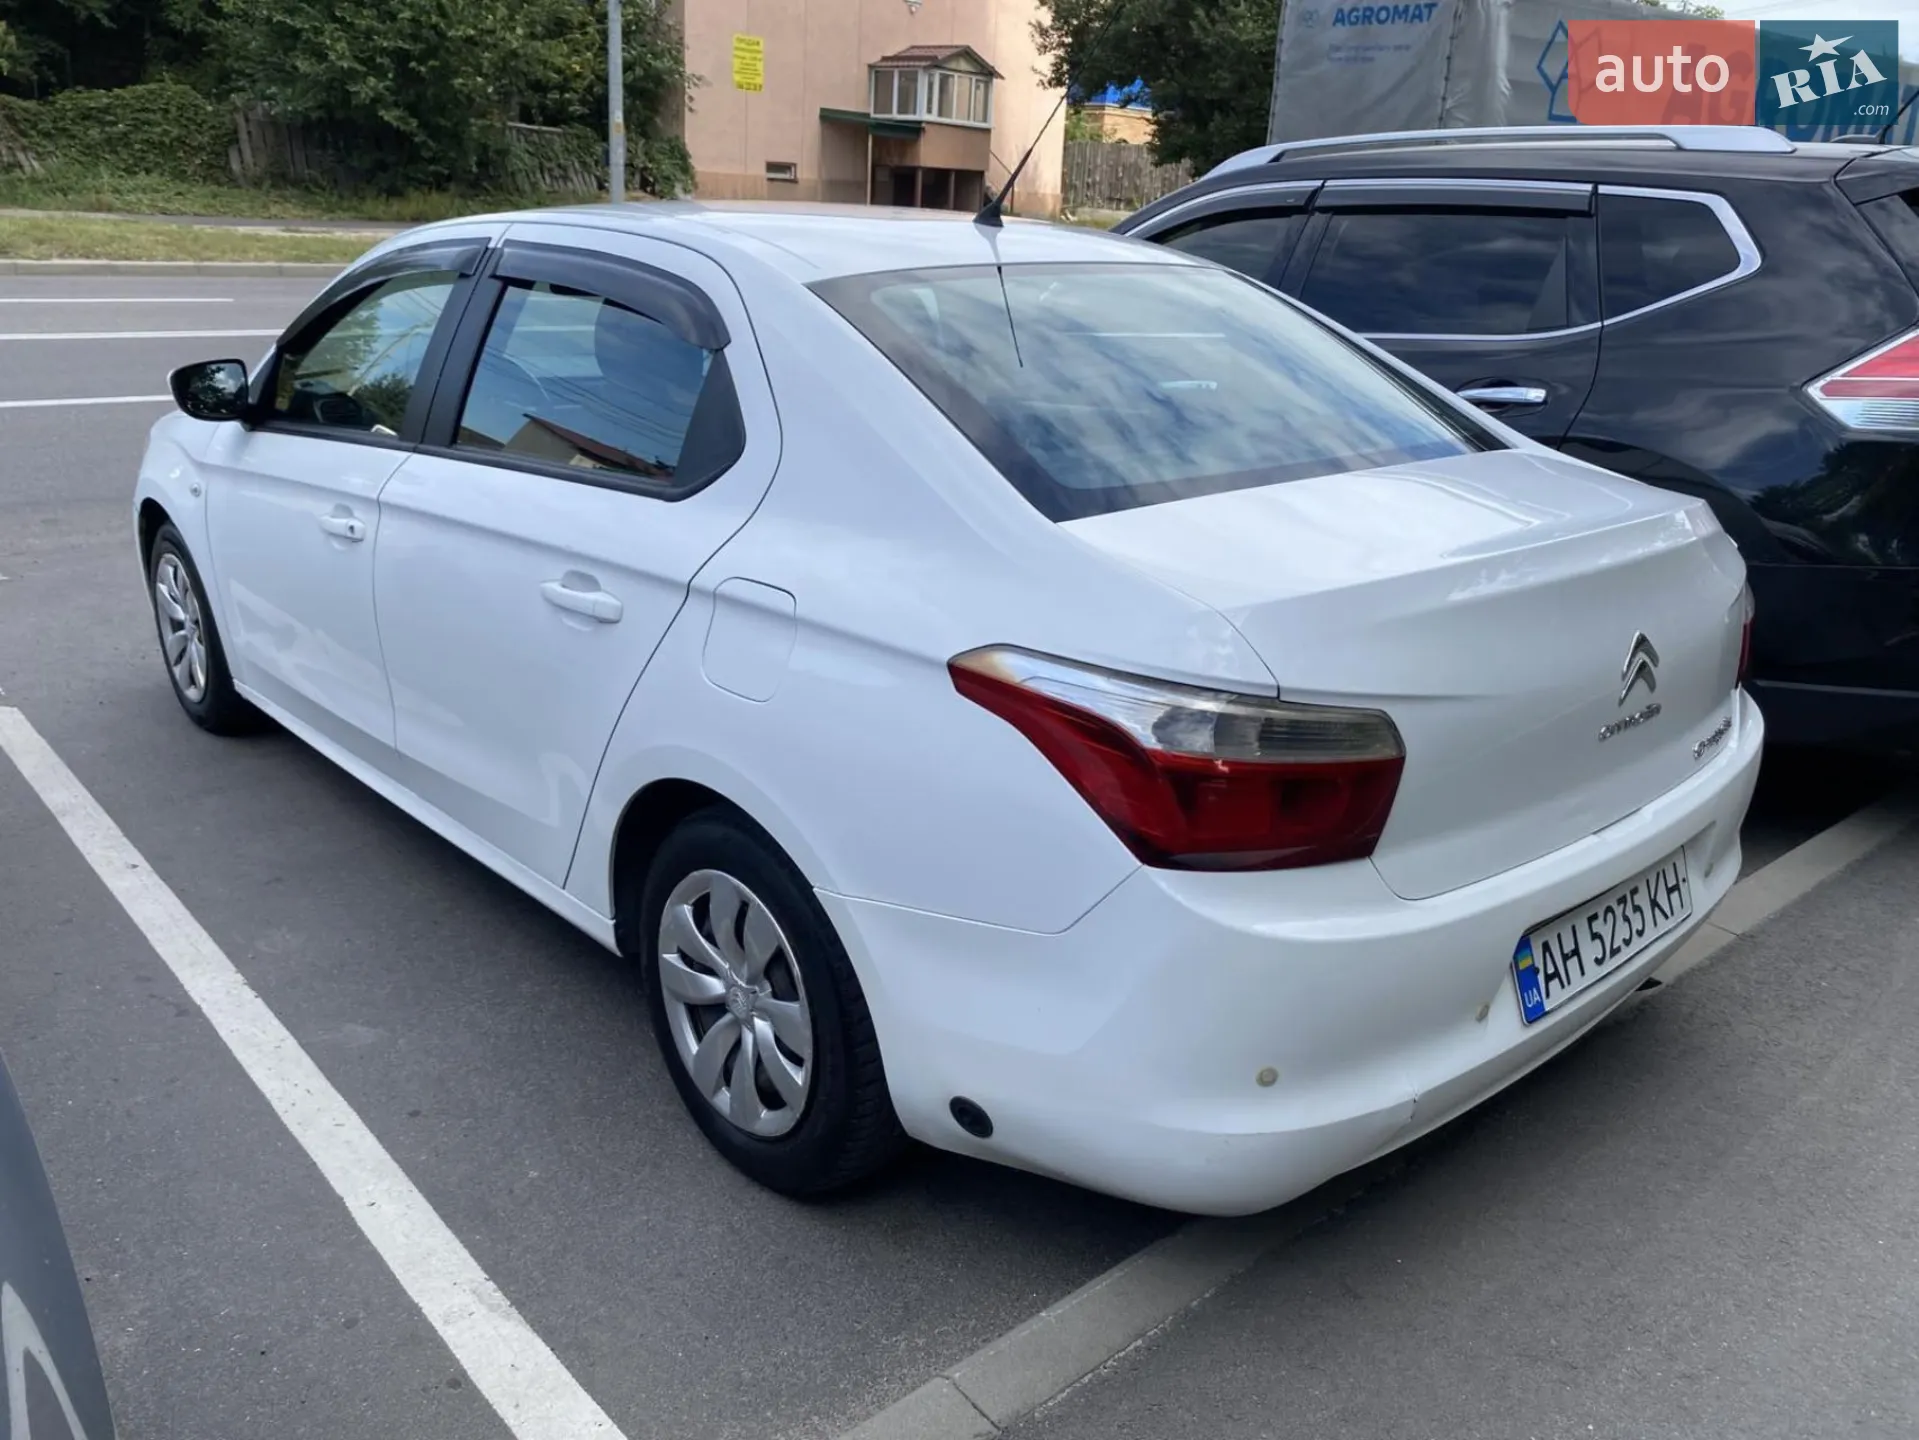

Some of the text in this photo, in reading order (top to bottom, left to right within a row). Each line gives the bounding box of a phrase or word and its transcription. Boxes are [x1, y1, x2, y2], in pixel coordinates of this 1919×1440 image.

[1332, 2, 1438, 27] AGROMAT
[1541, 862, 1684, 999] AH 5235 KH
[1524, 989, 1540, 1008] UA
